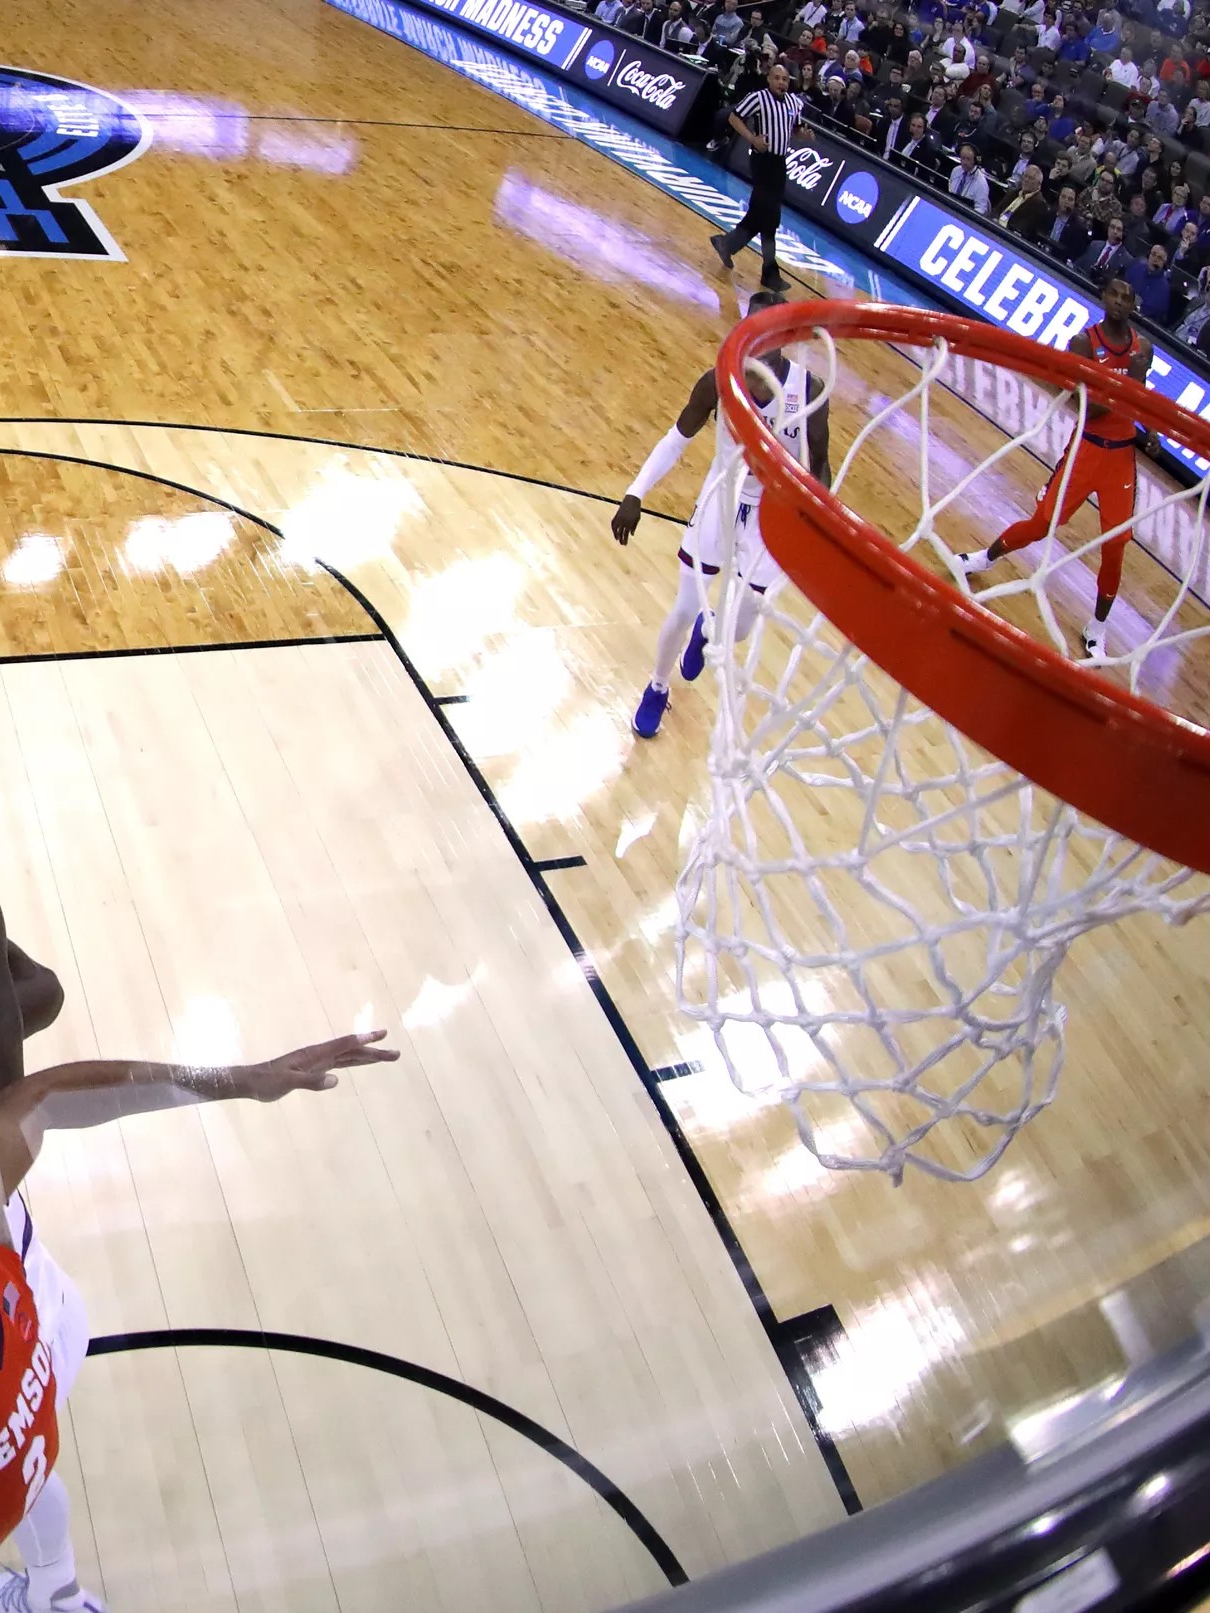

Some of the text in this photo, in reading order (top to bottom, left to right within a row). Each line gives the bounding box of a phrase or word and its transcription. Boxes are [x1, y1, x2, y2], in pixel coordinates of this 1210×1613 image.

[459, 0, 564, 55] MADNESS
[586, 56, 610, 74] NCAA
[616, 60, 686, 109] Coca-Cola
[46, 104, 99, 137] ELITE
[838, 190, 873, 218] NCAA
[919, 223, 1090, 352] CELEBR
